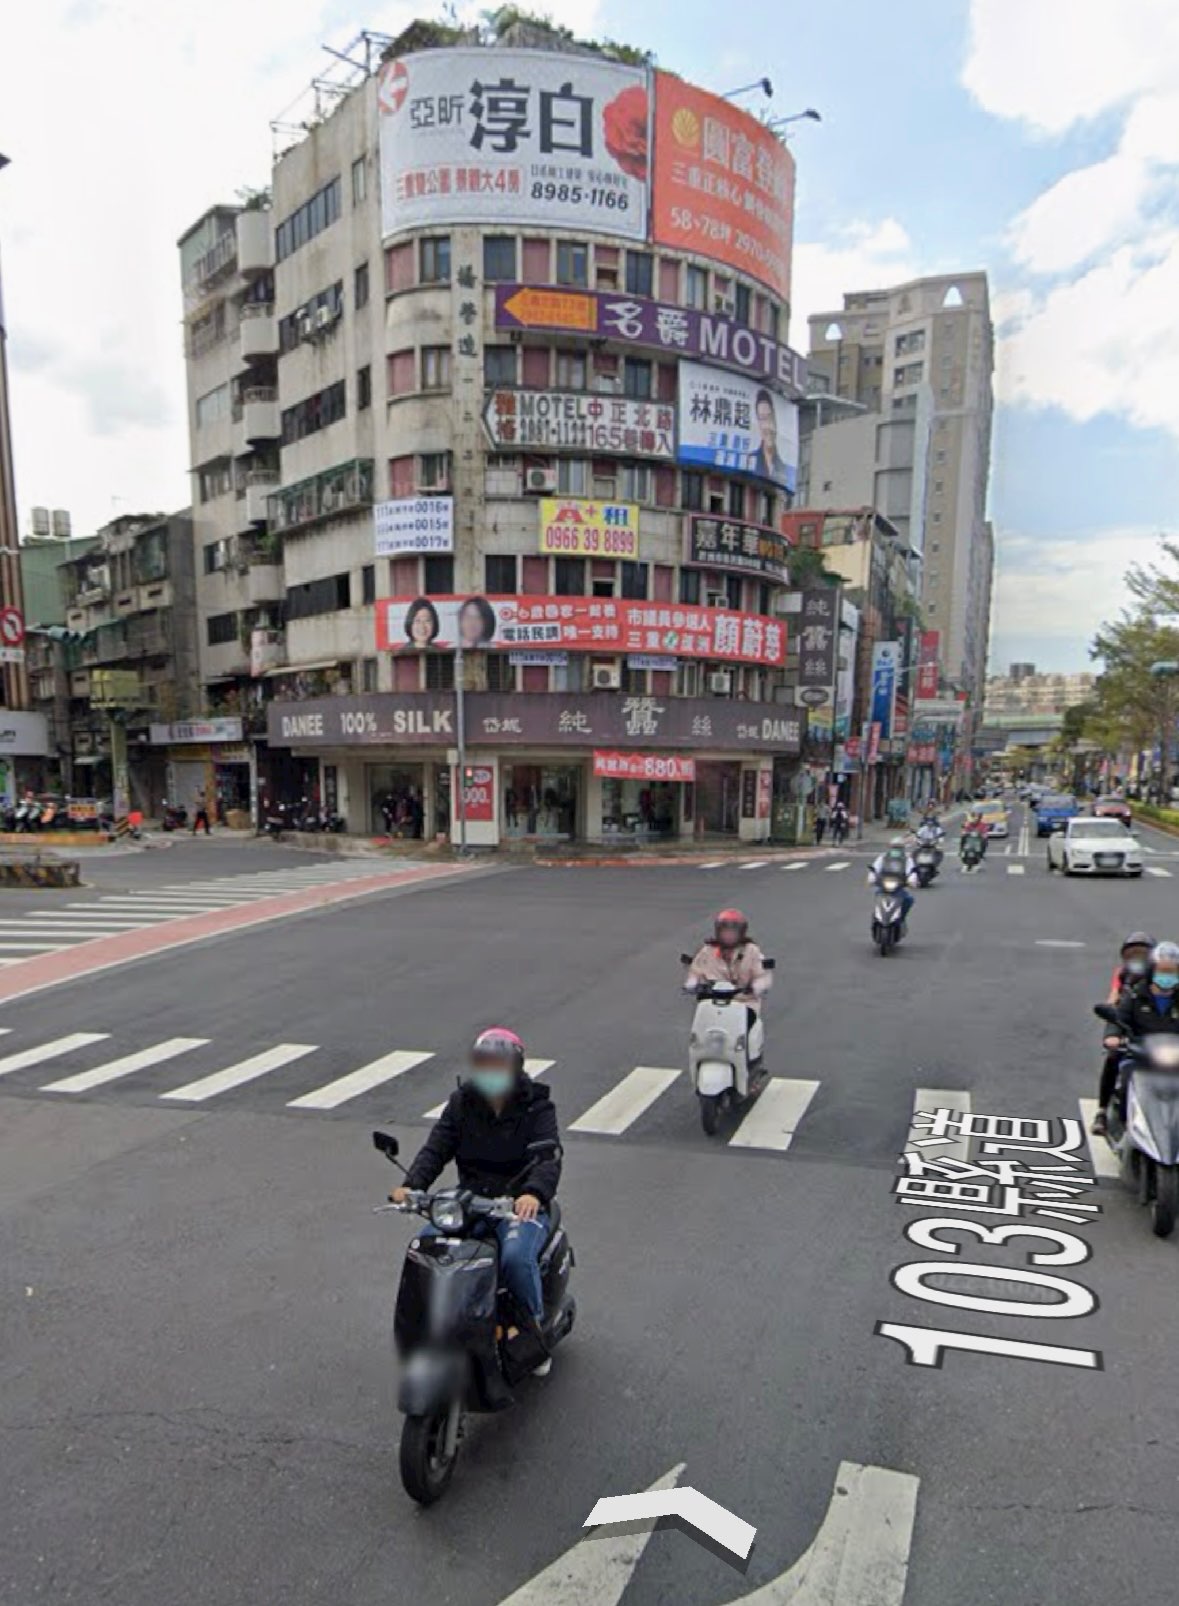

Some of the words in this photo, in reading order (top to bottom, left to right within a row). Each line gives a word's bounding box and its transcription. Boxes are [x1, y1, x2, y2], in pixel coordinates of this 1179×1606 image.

[469, 78, 594, 158] 淳白
[700, 317, 803, 391] MOTEL
[519, 394, 587, 420] MOTEL
[689, 393, 750, 431] 林鼎超
[603, 505, 629, 527] 租
[282, 714, 323, 738] DANEE
[340, 712, 378, 734] 100%
[394, 709, 454, 734] SILK
